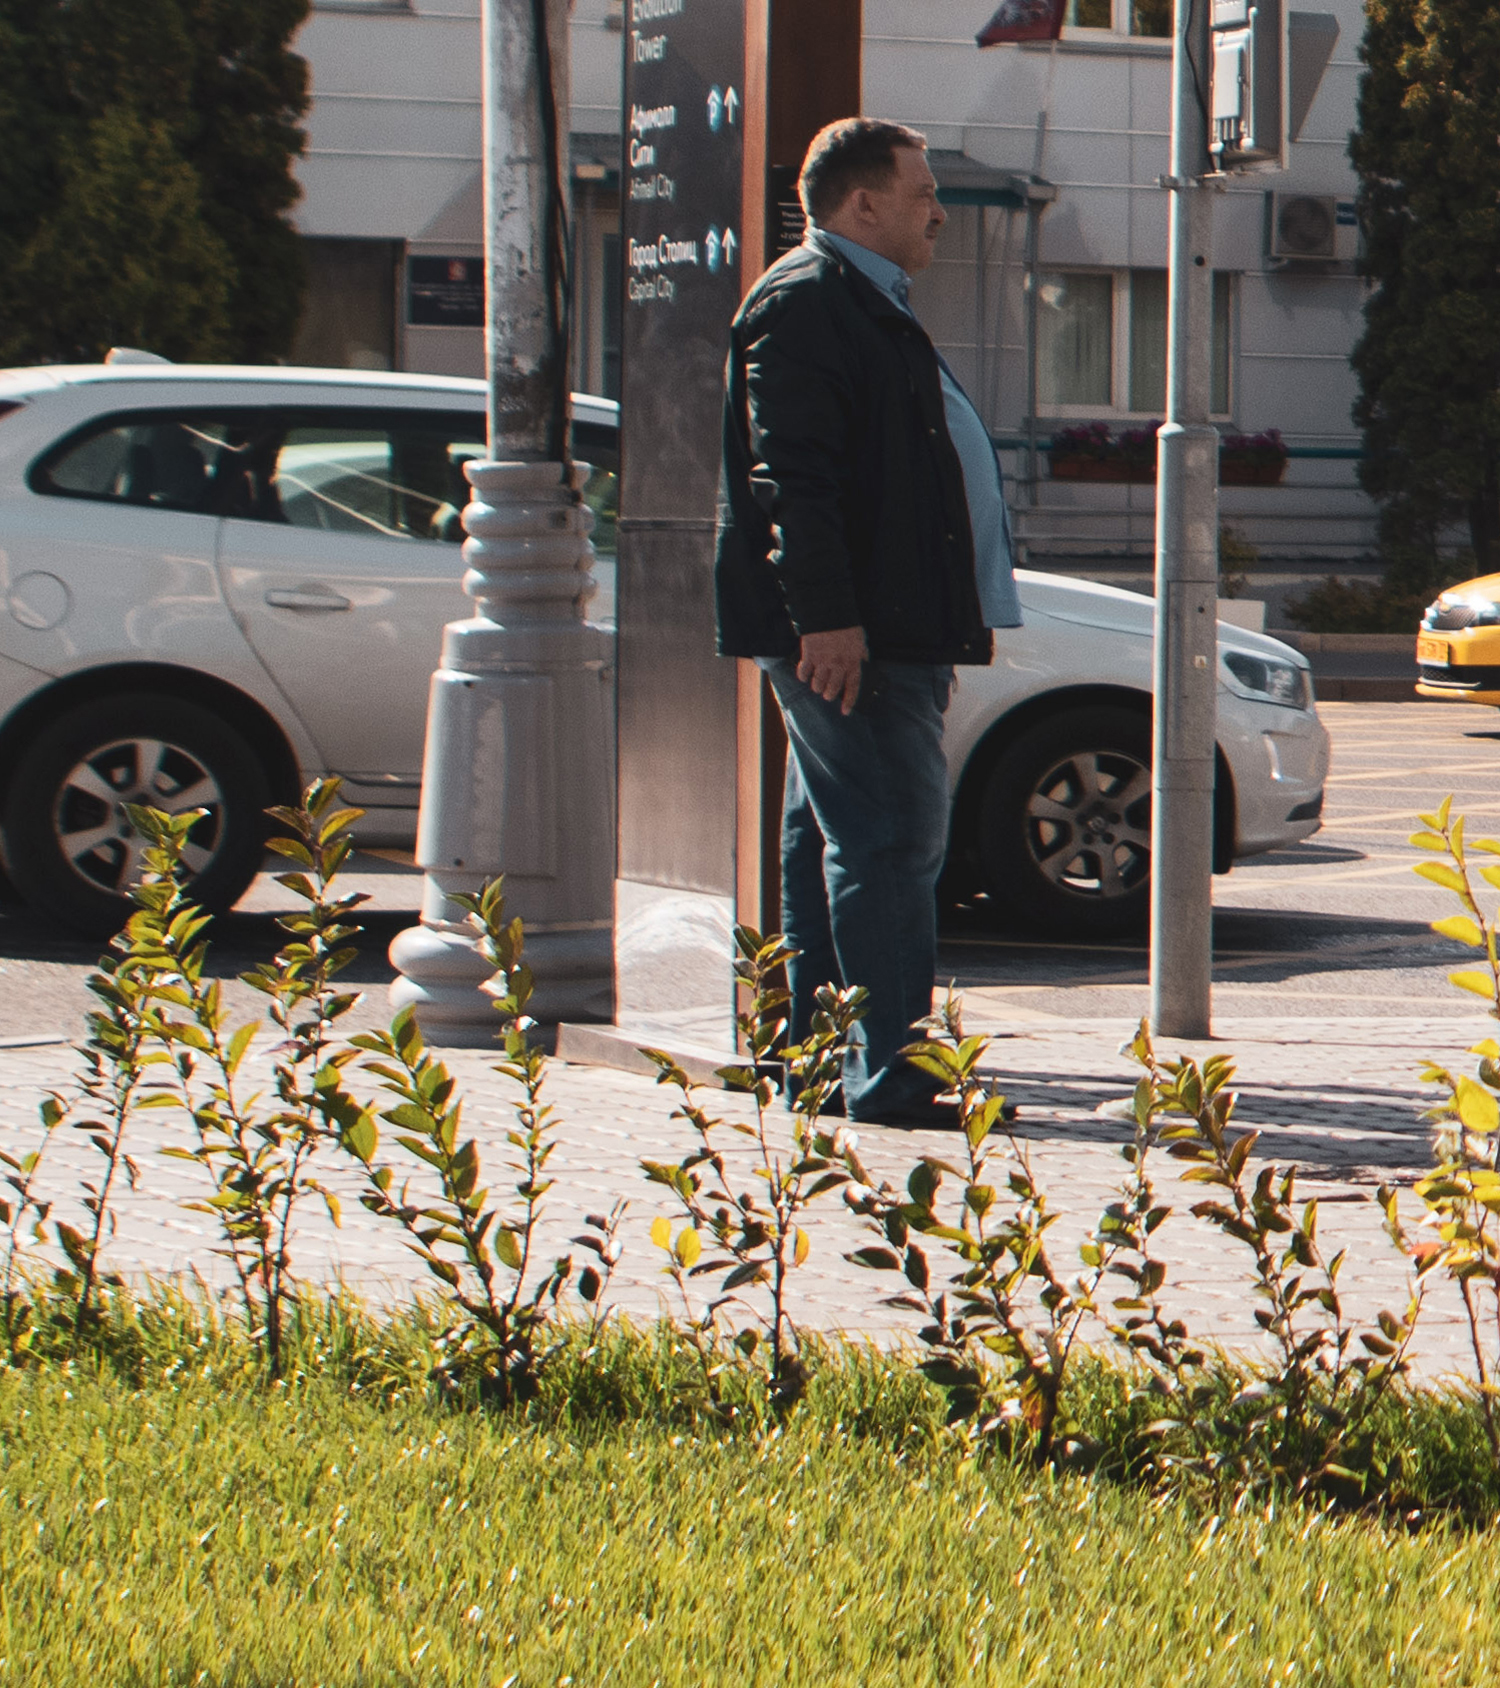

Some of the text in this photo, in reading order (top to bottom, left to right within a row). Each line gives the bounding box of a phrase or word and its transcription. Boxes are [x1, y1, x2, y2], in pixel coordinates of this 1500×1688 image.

[631, 30, 667, 63] Tower
[657, 172, 675, 203] City
[629, 233, 698, 274] Город Столиц
[628, 272, 675, 306] Capital City
